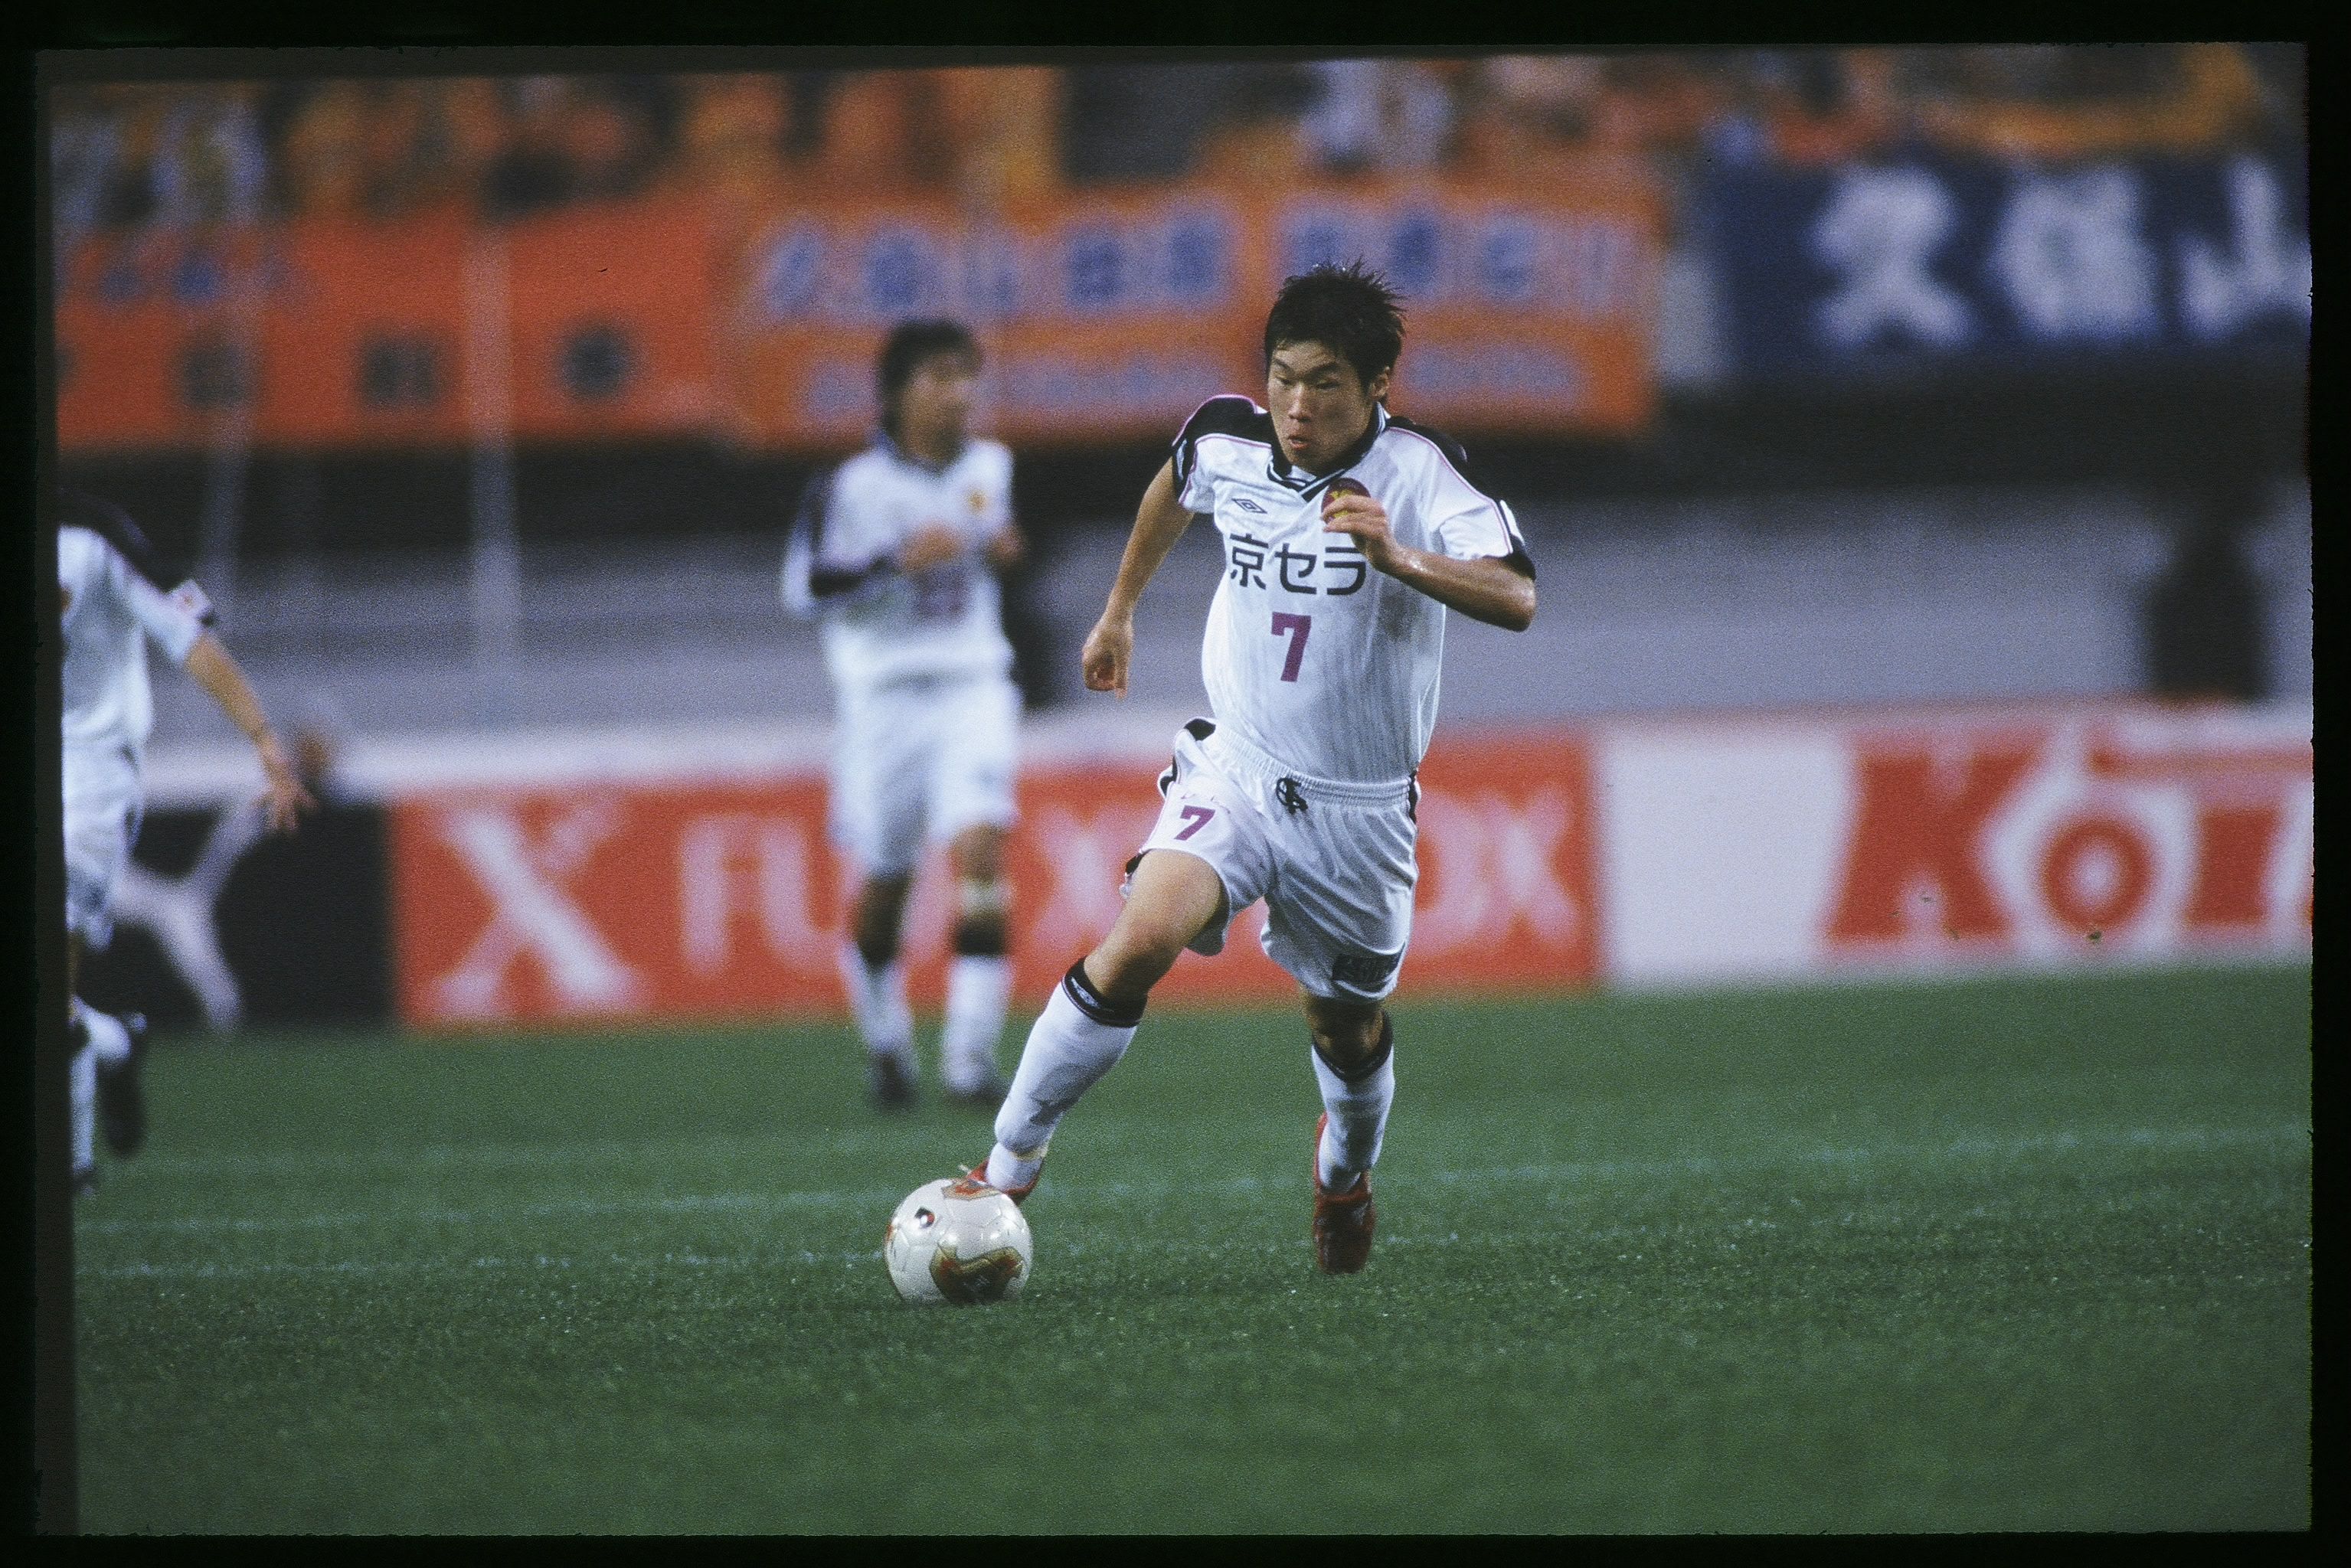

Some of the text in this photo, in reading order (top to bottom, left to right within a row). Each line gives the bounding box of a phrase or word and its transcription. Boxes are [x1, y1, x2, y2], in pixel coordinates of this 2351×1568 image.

[1229, 533, 1366, 596] 京セラ
[1271, 612, 1312, 682] 7
[1174, 805, 1216, 841] 7
